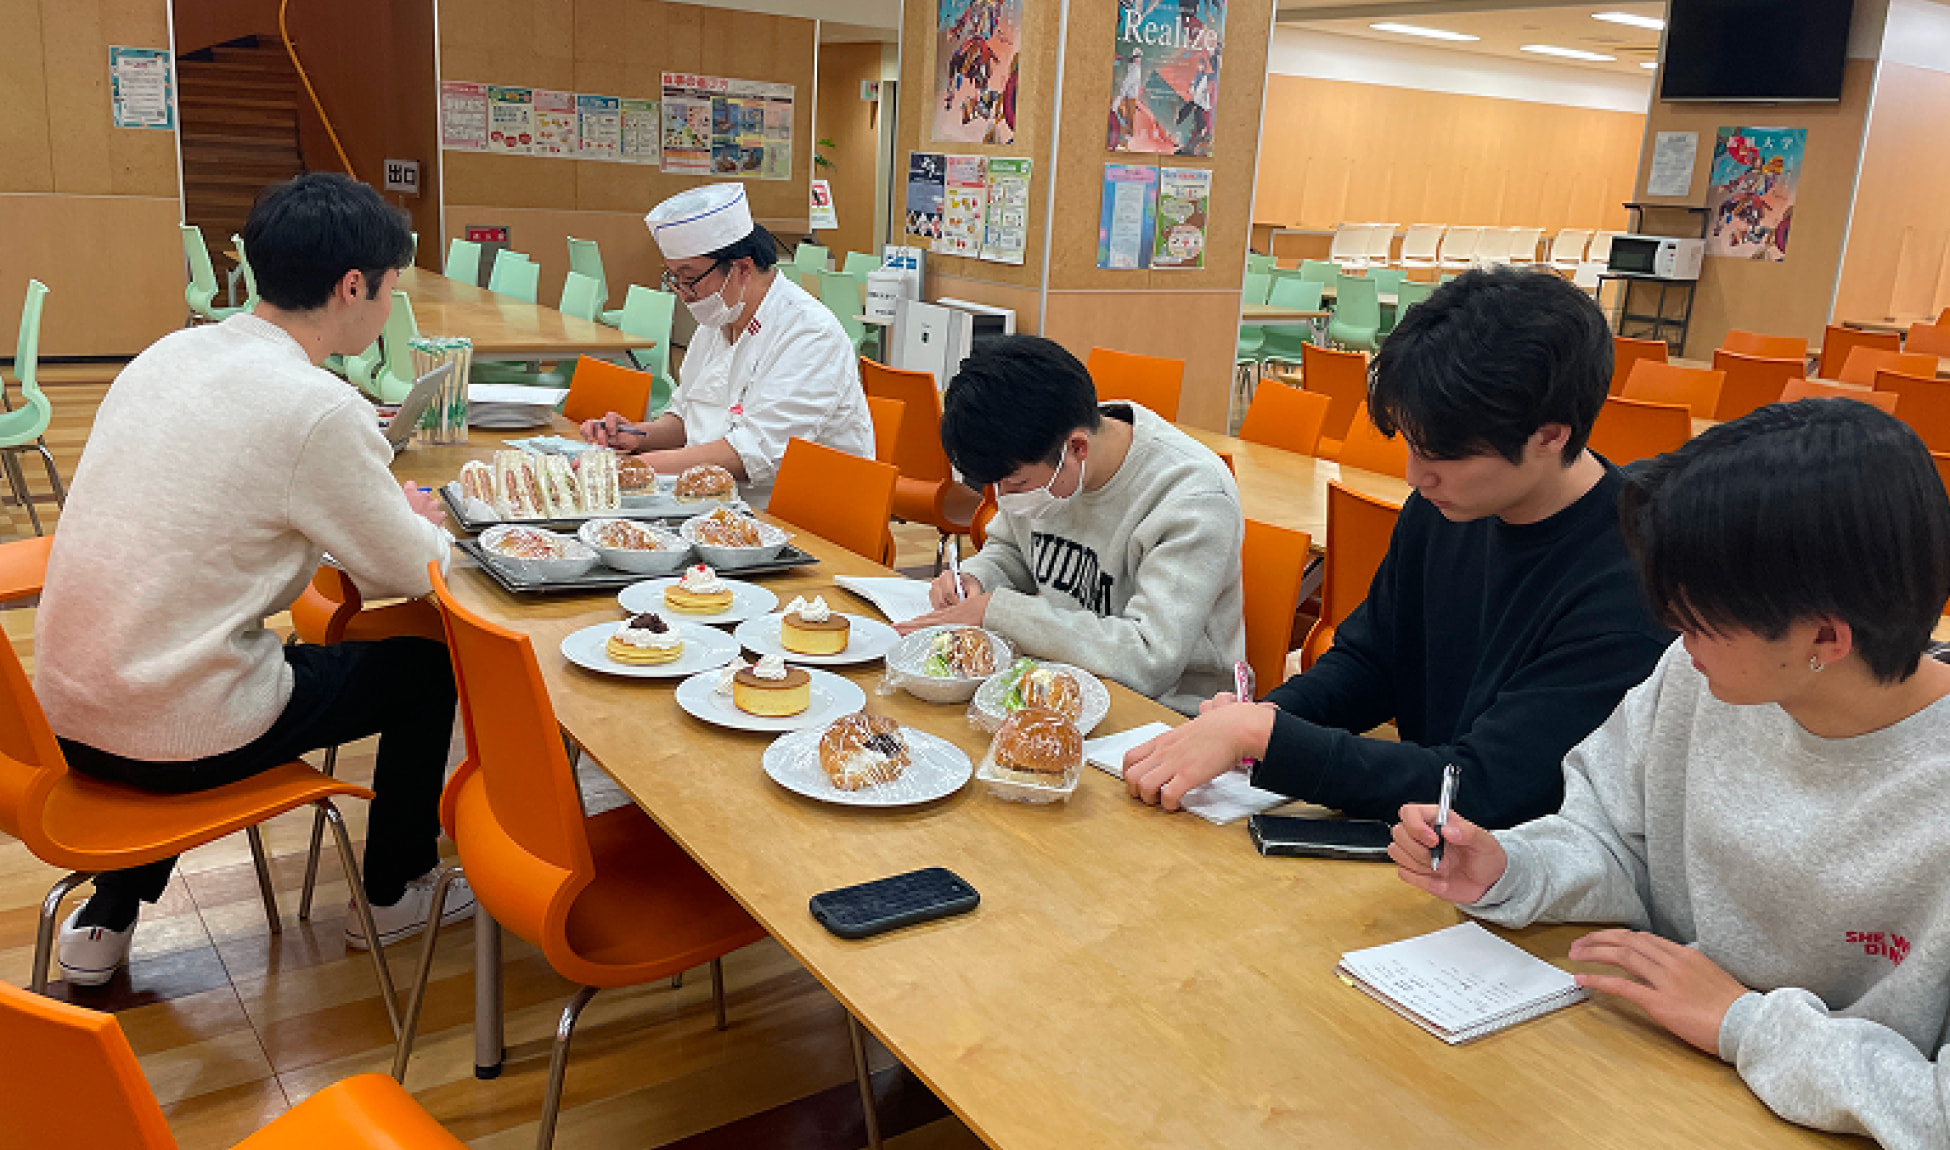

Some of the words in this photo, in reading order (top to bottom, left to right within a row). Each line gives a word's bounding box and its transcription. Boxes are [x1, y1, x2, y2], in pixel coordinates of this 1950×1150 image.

[1122, 9, 1217, 50] Realize
[389, 164, 415, 185] 出口
[1845, 931, 1885, 943] SHE
